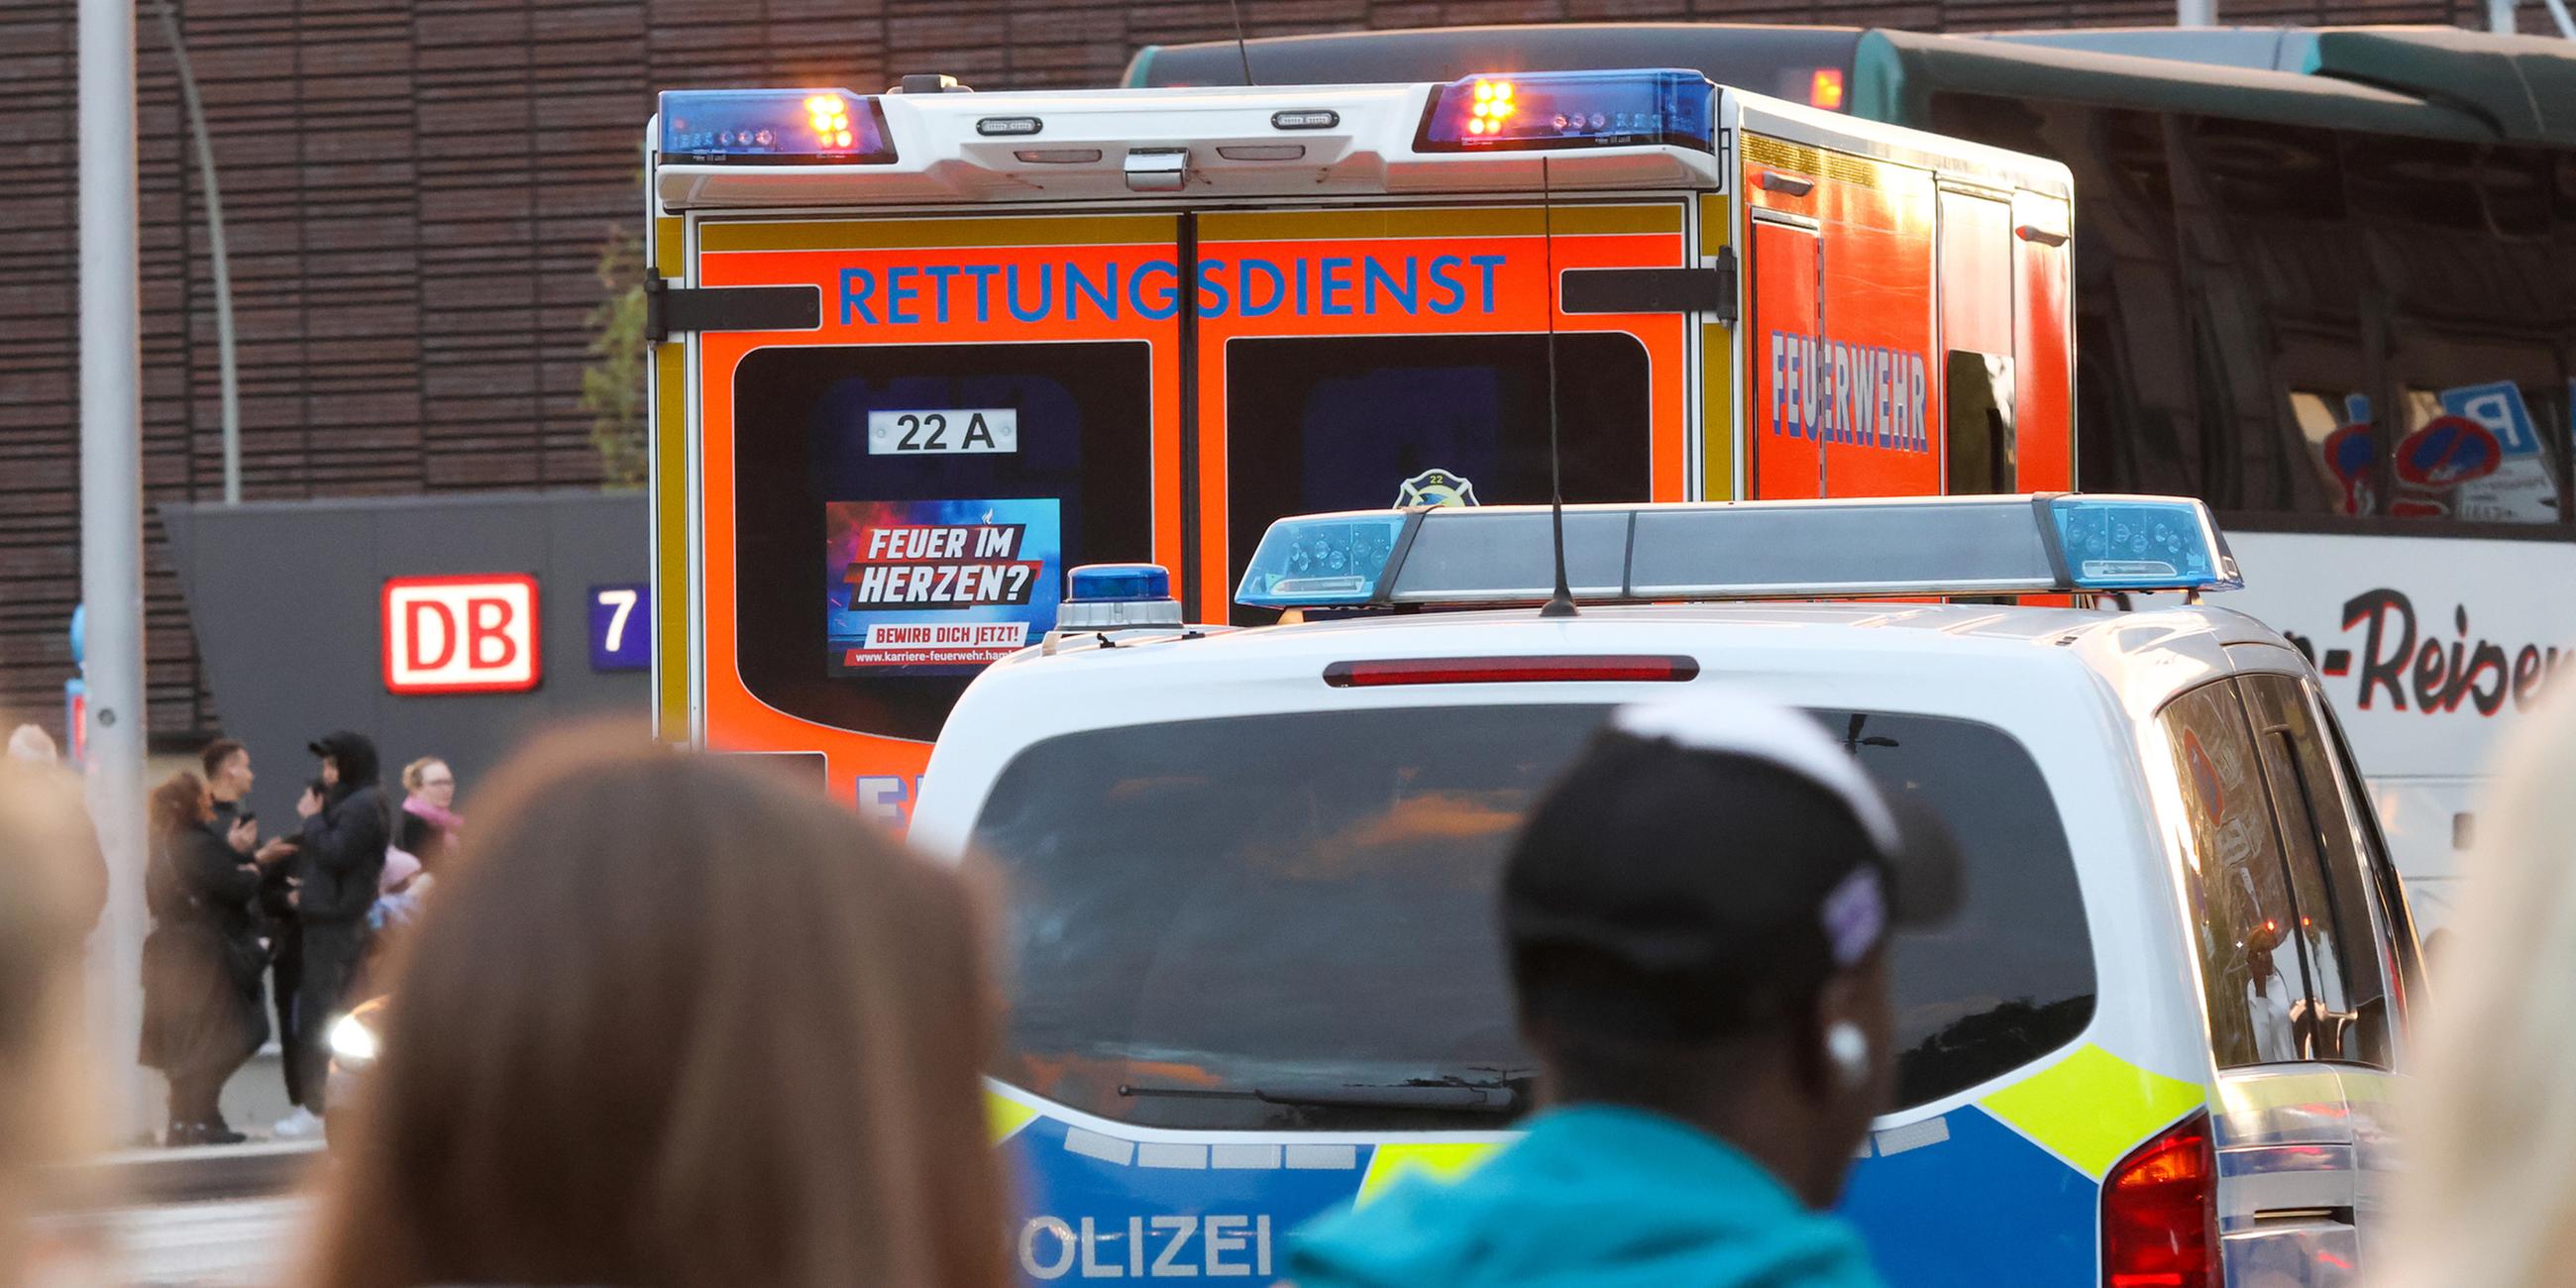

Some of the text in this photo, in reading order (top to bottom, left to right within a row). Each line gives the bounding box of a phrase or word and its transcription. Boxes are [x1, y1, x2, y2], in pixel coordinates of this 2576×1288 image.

[839, 255, 1506, 326] RETTUNGSDIENST
[1771, 330, 1928, 454] FEUERWEHR
[897, 412, 996, 450] 22 A
[868, 527, 1015, 559] FEUER IM
[858, 565, 1029, 602] HERZEN?
[405, 597, 516, 671] DB
[598, 590, 637, 652] 7
[876, 625, 1019, 646] BEWIRB DICH JETZT!
[855, 649, 1013, 663] www.karriere-feuerwehr.ham
[1018, 1215, 1271, 1280] OLIZEI
